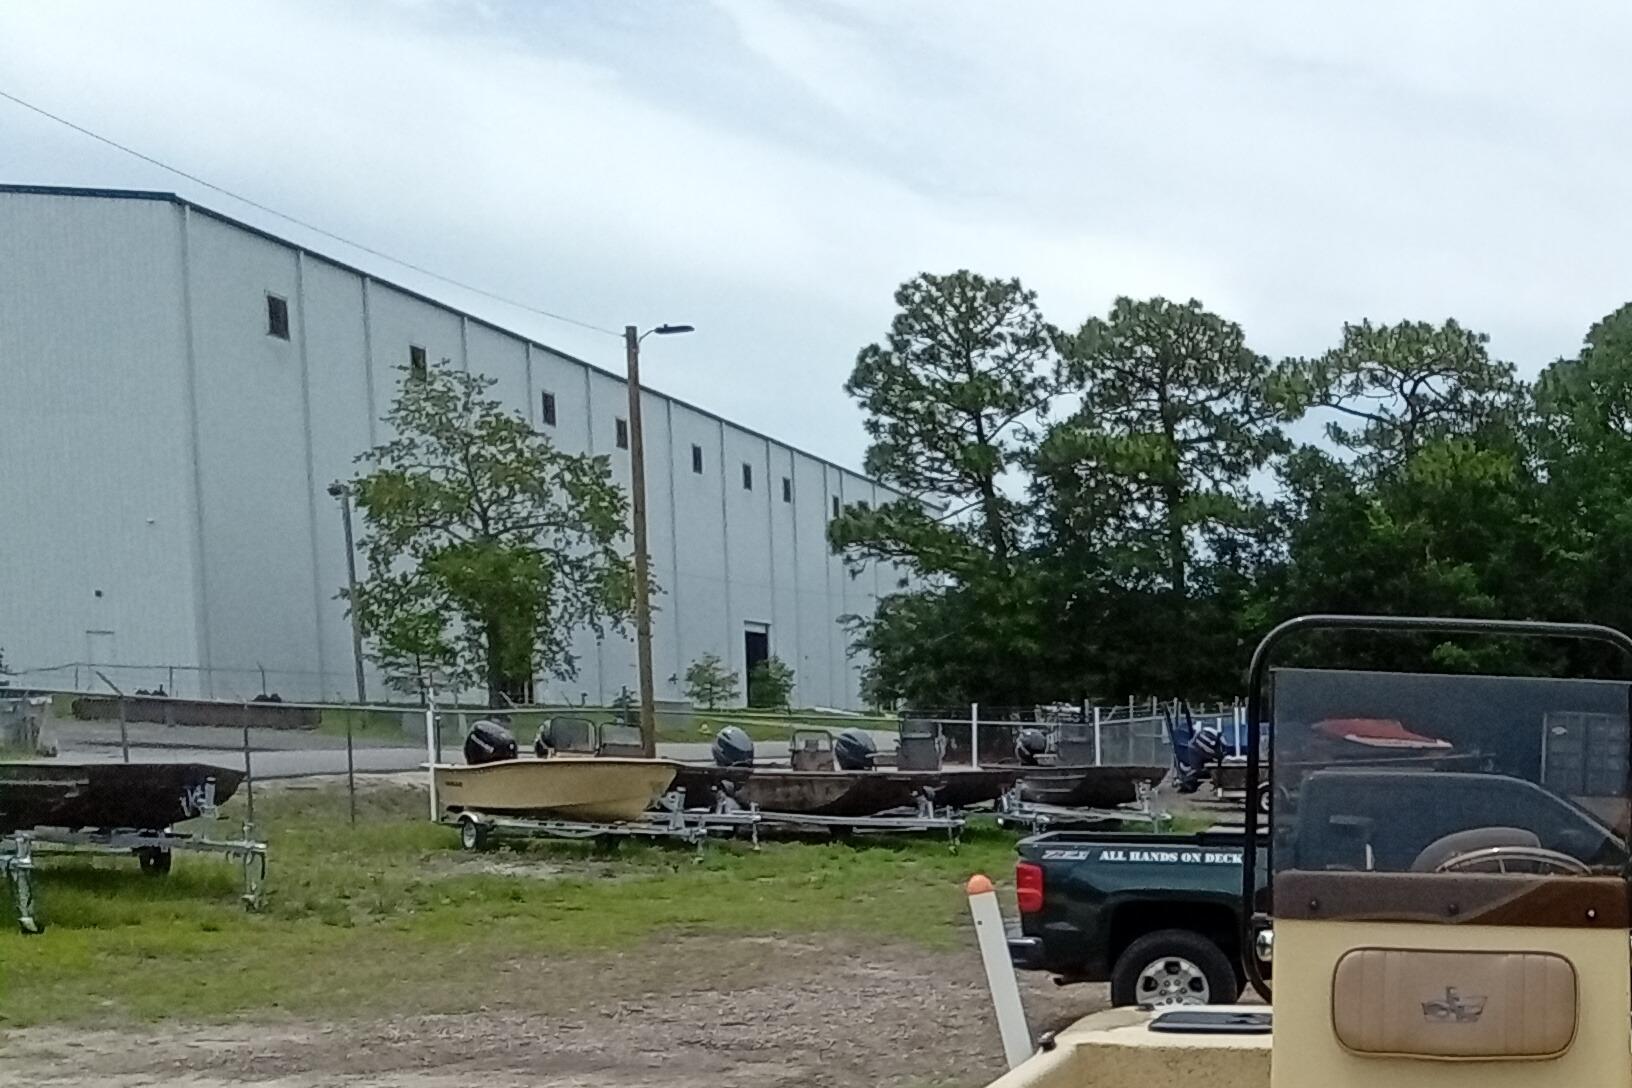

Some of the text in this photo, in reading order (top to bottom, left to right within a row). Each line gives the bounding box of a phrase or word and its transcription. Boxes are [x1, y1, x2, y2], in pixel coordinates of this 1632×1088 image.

[1099, 850, 1244, 864] ALL HANDS ON DECK
